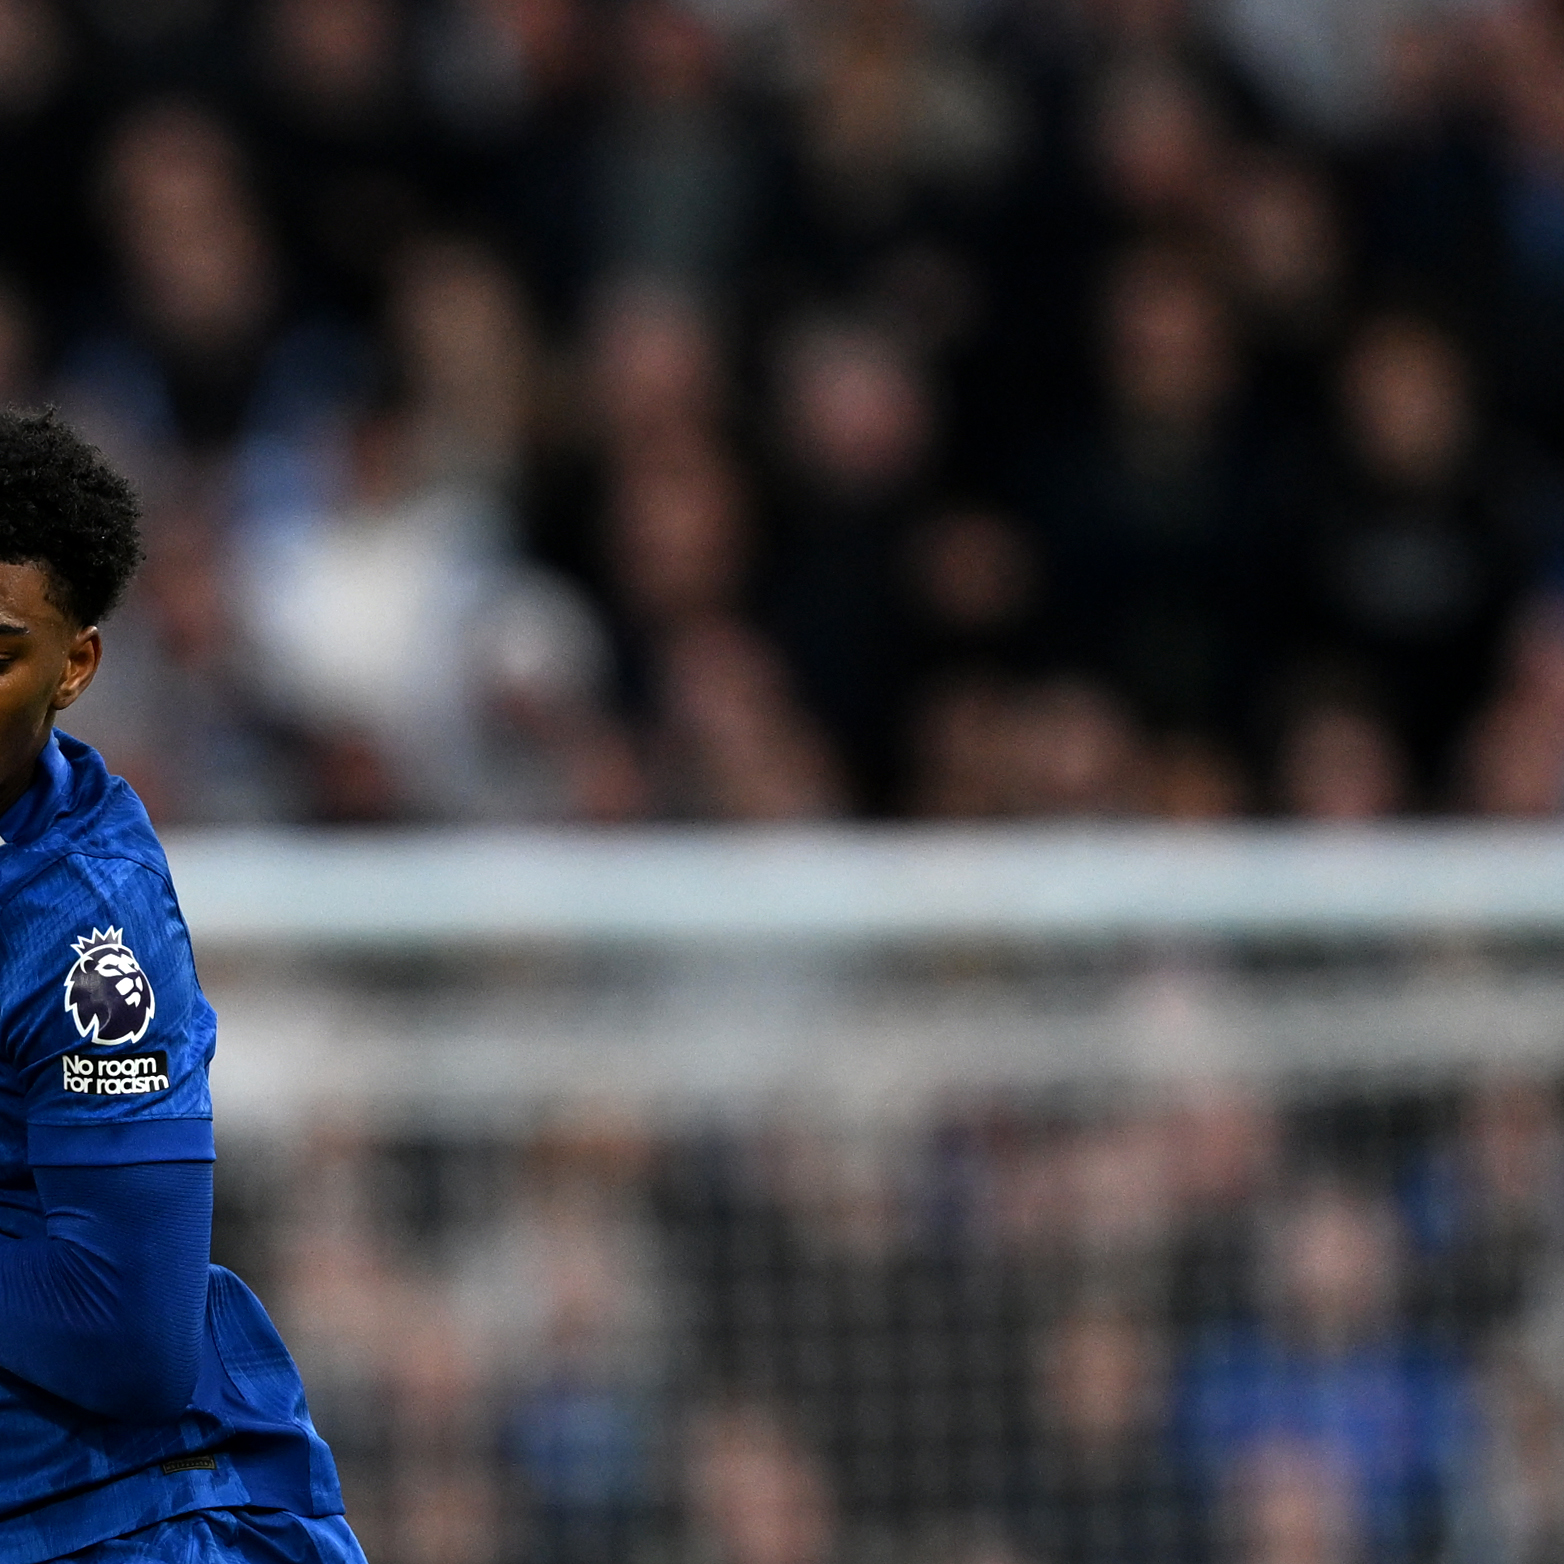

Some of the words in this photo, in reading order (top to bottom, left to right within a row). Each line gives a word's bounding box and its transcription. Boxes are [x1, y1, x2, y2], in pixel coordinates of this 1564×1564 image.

[62, 1054, 94, 1075] No
[98, 1057, 157, 1077] room
[63, 1071, 93, 1093] for
[96, 1074, 170, 1095] racism
